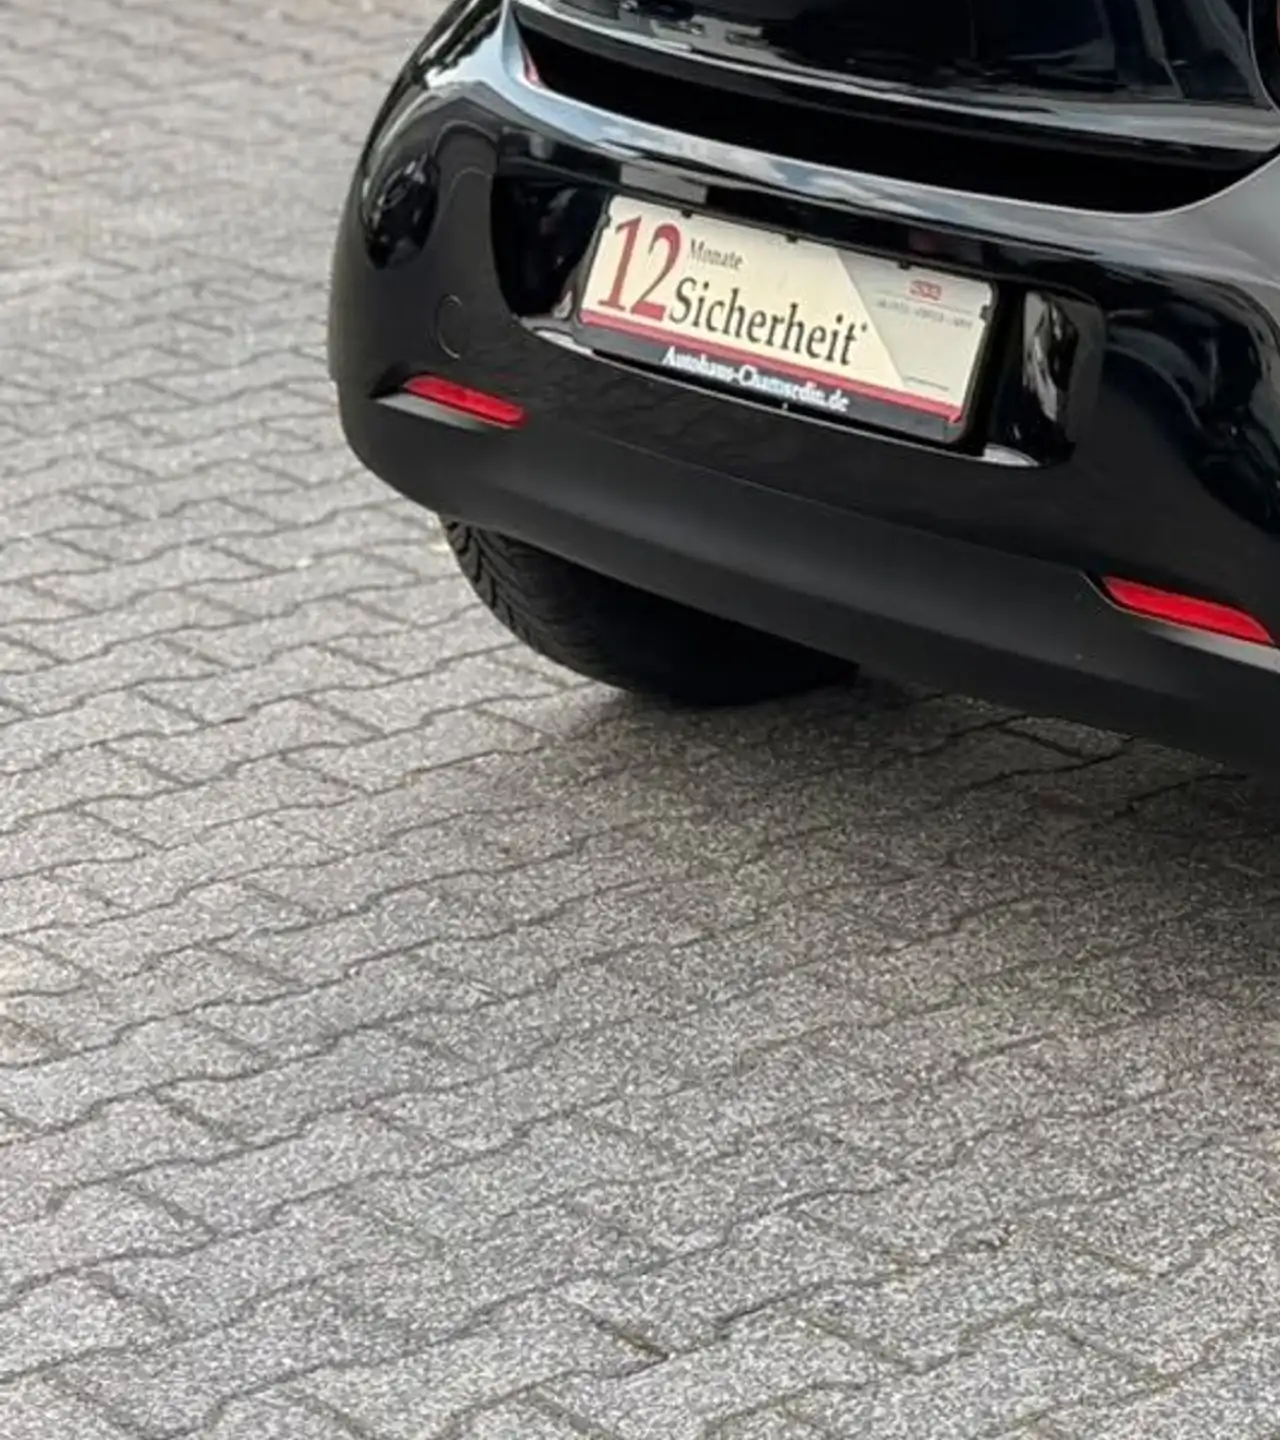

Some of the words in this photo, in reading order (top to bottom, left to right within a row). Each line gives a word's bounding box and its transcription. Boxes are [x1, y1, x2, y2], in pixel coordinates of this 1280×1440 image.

[597, 215, 682, 322] 12
[667, 276, 859, 366] Sicherheit
[661, 345, 850, 412] Autohaus-Chamsedin.de
